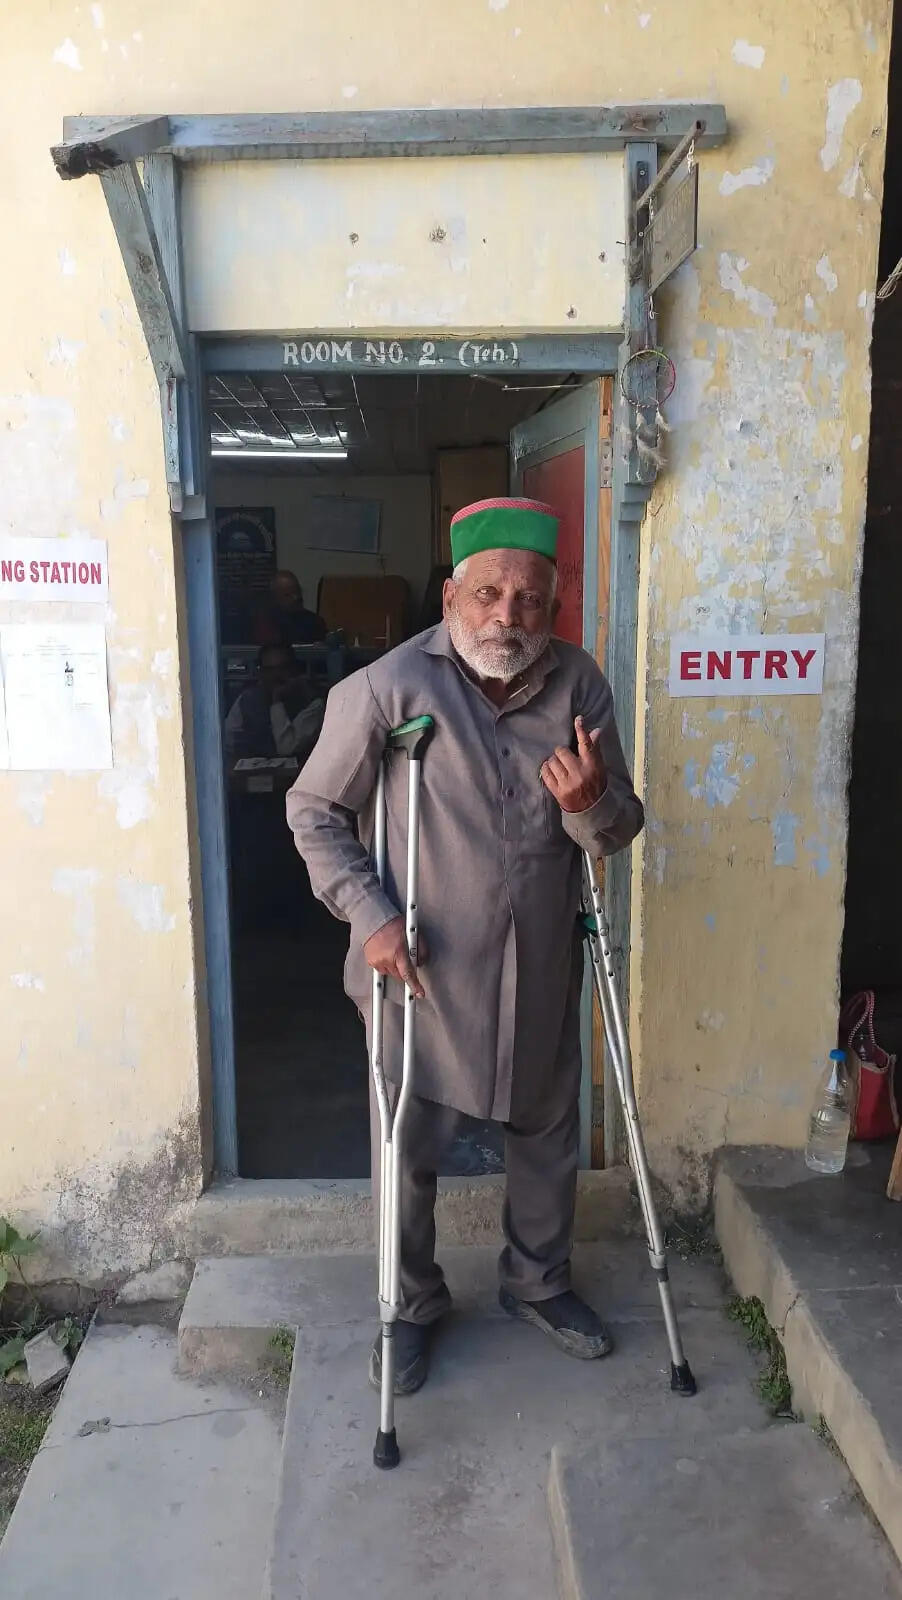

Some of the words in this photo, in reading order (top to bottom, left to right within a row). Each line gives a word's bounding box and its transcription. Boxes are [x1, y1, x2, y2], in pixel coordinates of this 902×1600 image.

[282, 341, 354, 366] ROOM
[364, 341, 409, 365] NO.
[418, 341, 444, 366] 2.
[30, 560, 102, 585] STATION
[680, 650, 817, 680] ENTRY
